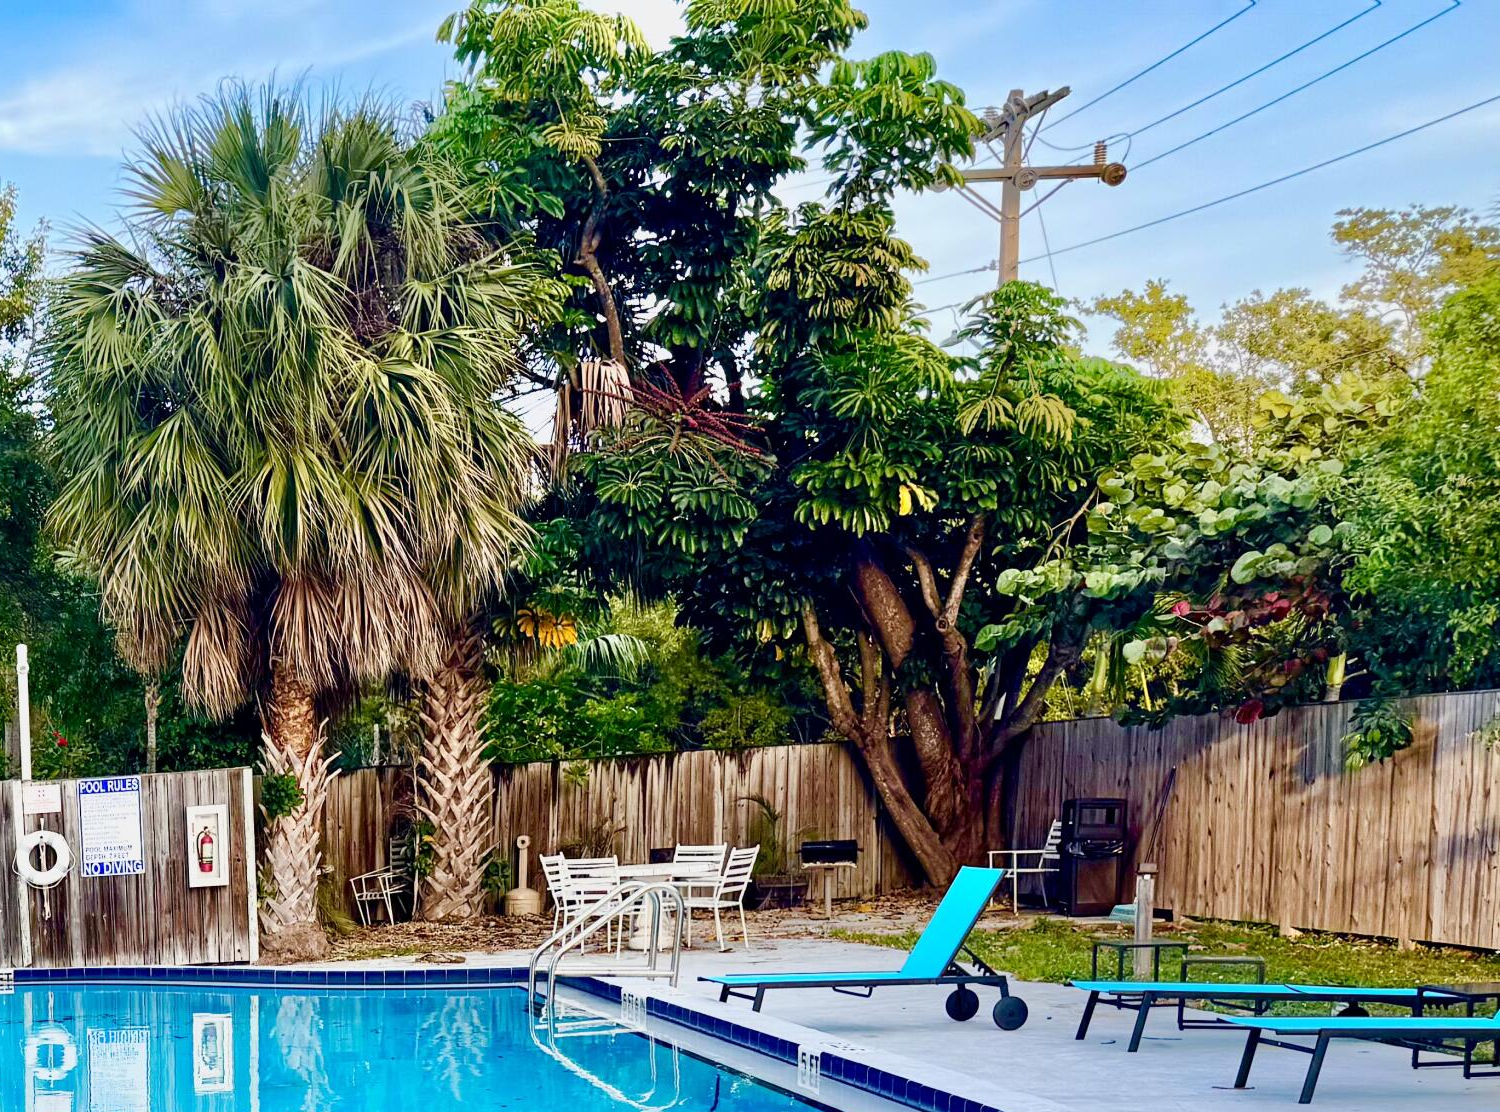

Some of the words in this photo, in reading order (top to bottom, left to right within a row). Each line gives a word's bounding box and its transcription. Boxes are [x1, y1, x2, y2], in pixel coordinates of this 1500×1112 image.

[80, 781, 106, 793] POOL
[107, 778, 139, 791] RULES
[84, 862, 101, 875] NO
[103, 860, 143, 874] DIVING
[802, 1052, 807, 1070] 5
[810, 1054, 819, 1074] FT
